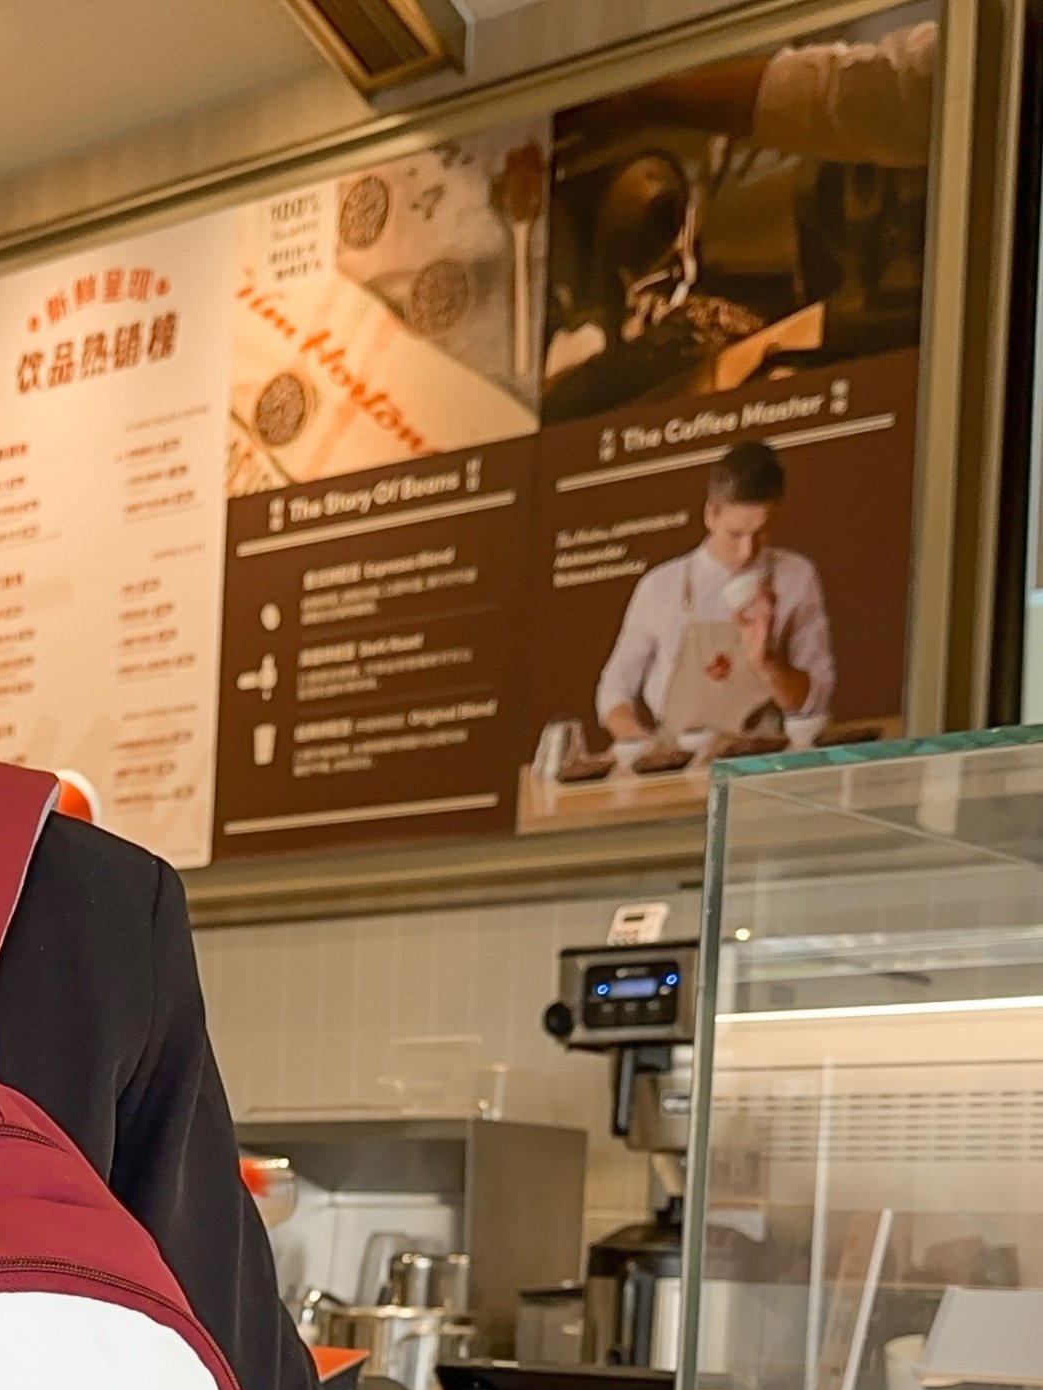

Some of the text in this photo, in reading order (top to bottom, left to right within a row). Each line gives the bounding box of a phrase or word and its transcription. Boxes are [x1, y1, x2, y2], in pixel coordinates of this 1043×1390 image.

[16, 310, 180, 394] 饮品热销榜
[621, 425, 663, 452] The
[664, 409, 739, 445] Coffee
